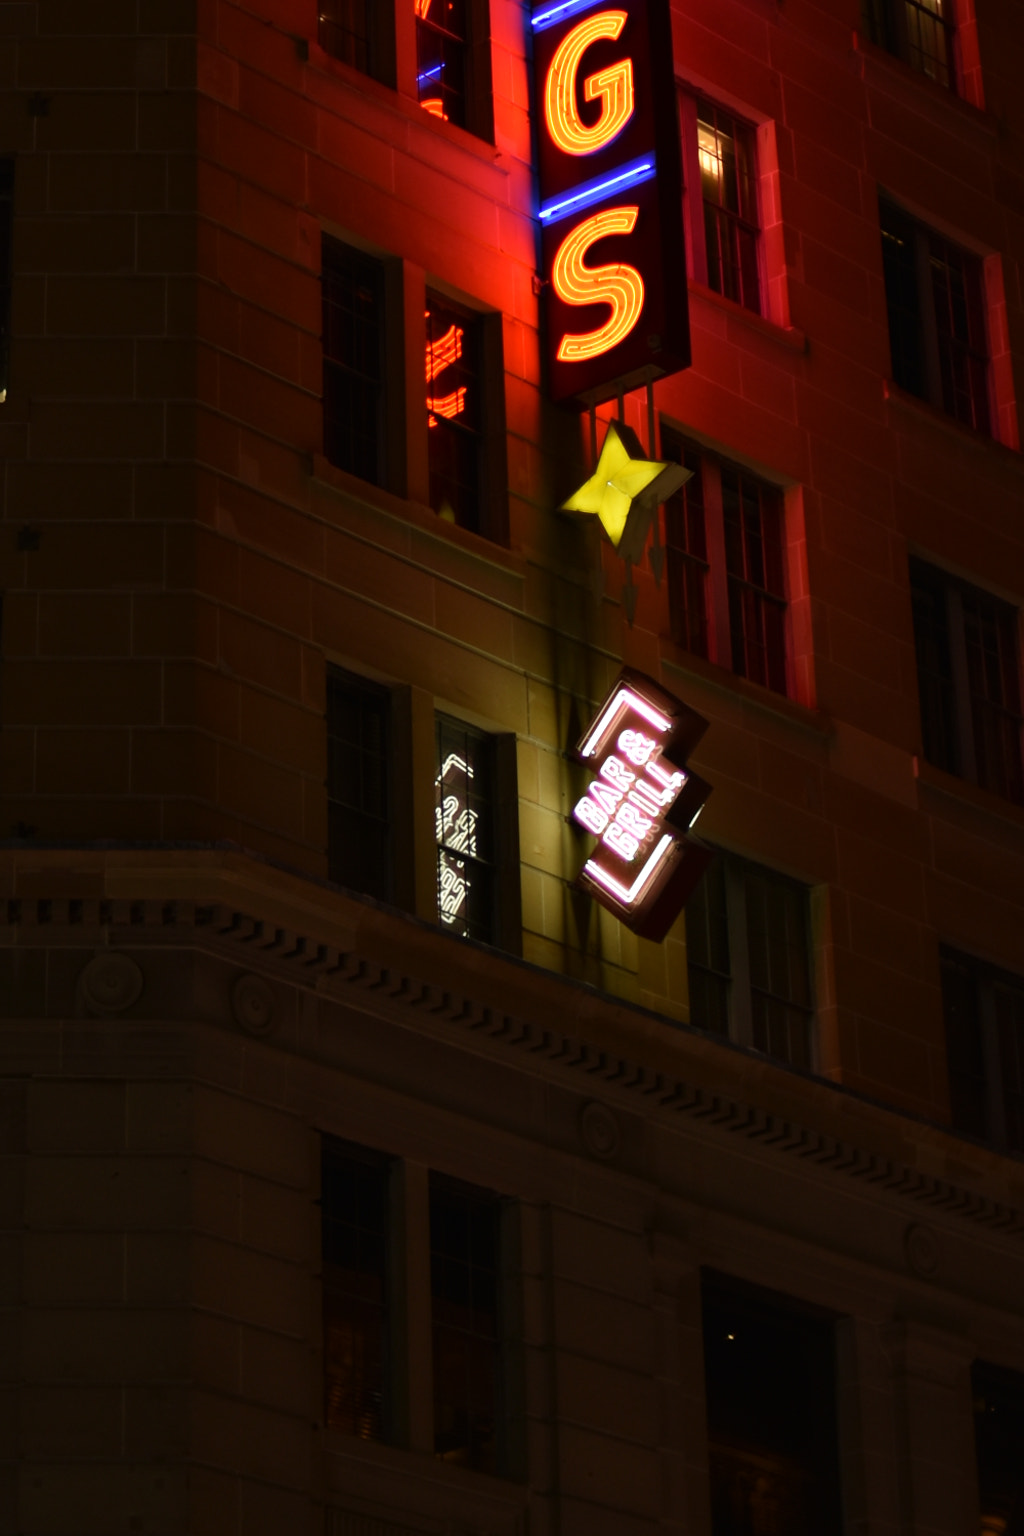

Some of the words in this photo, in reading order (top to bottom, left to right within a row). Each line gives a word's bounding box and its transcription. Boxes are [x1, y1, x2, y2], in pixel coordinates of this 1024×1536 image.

[574, 755, 636, 835] BAR
[617, 729, 656, 765] &
[602, 761, 686, 861] GRILL
